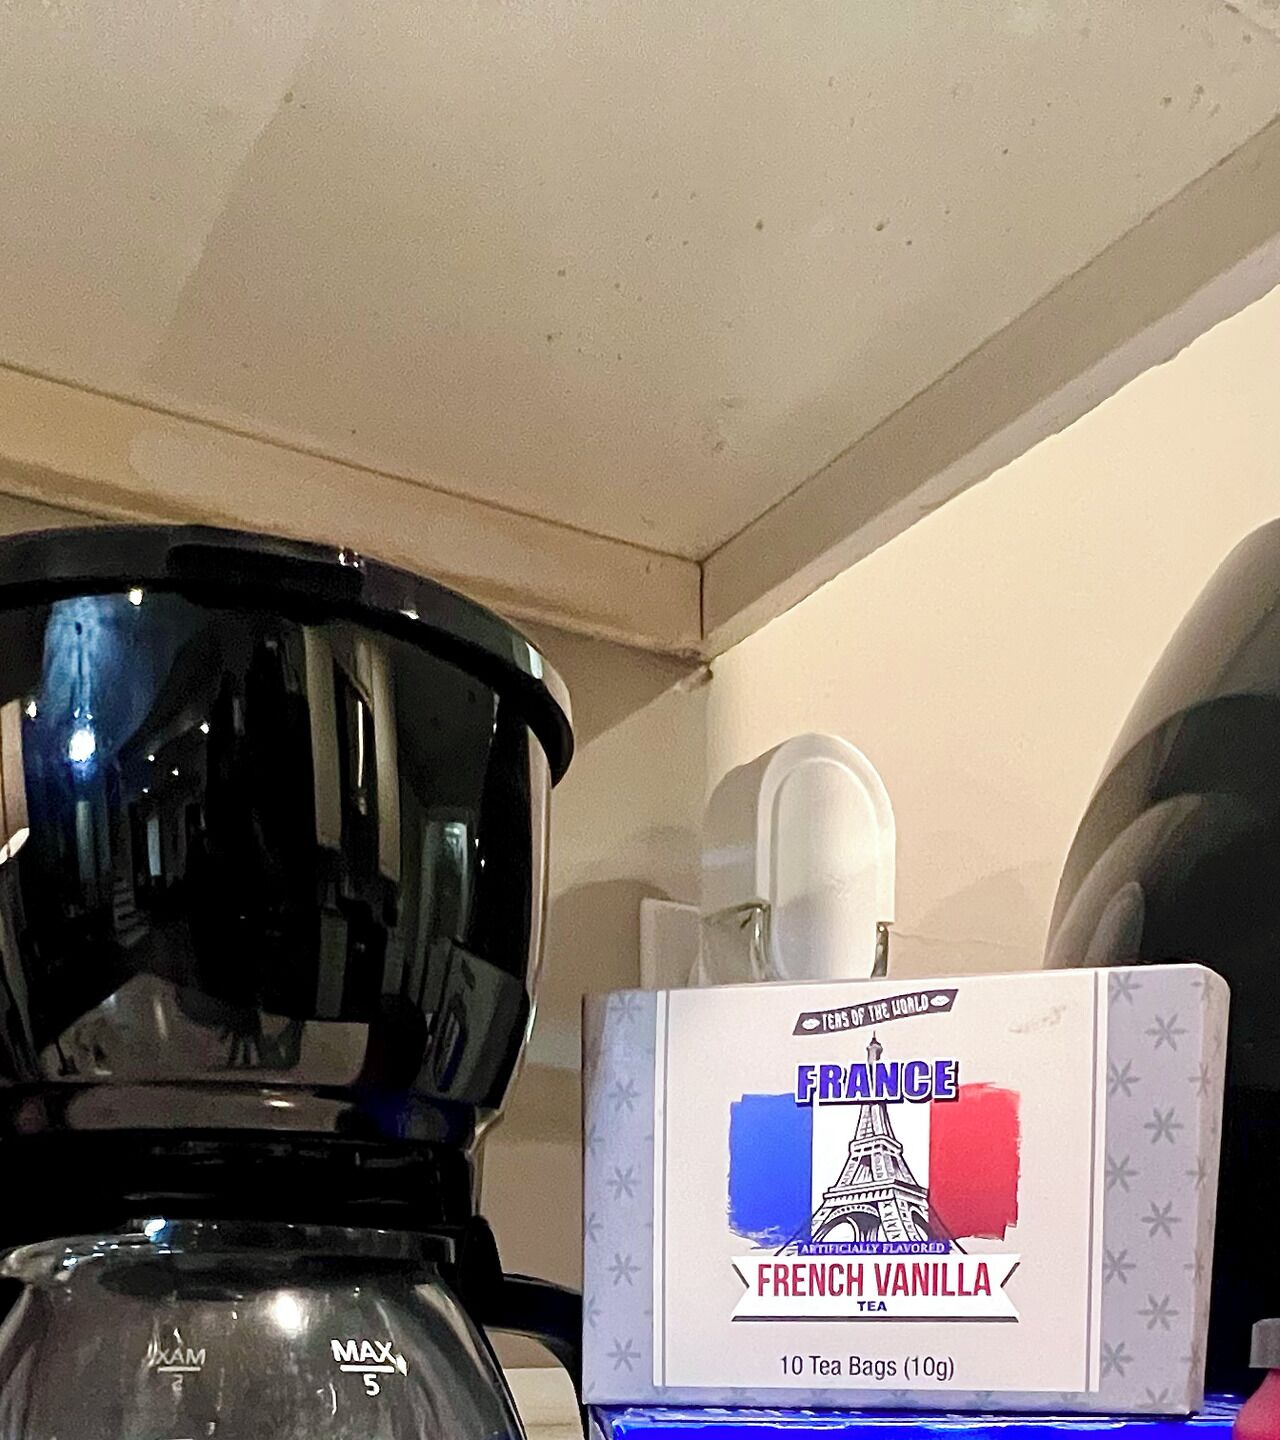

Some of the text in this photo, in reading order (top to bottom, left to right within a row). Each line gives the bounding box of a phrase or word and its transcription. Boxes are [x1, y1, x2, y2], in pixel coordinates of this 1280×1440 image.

[822, 994, 929, 1031] TEAS OF THE WORLD
[796, 1060, 957, 1102] FRANCE
[801, 1242, 945, 1254] ARTIFICIALLY FLAVORED
[758, 1262, 991, 1296] FRENCH VANILLA
[857, 1301, 887, 1312] TEA
[331, 1339, 395, 1363] MAX
[781, 1355, 954, 1381] 10 Tea Bags (10g)
[363, 1374, 380, 1396] 5
